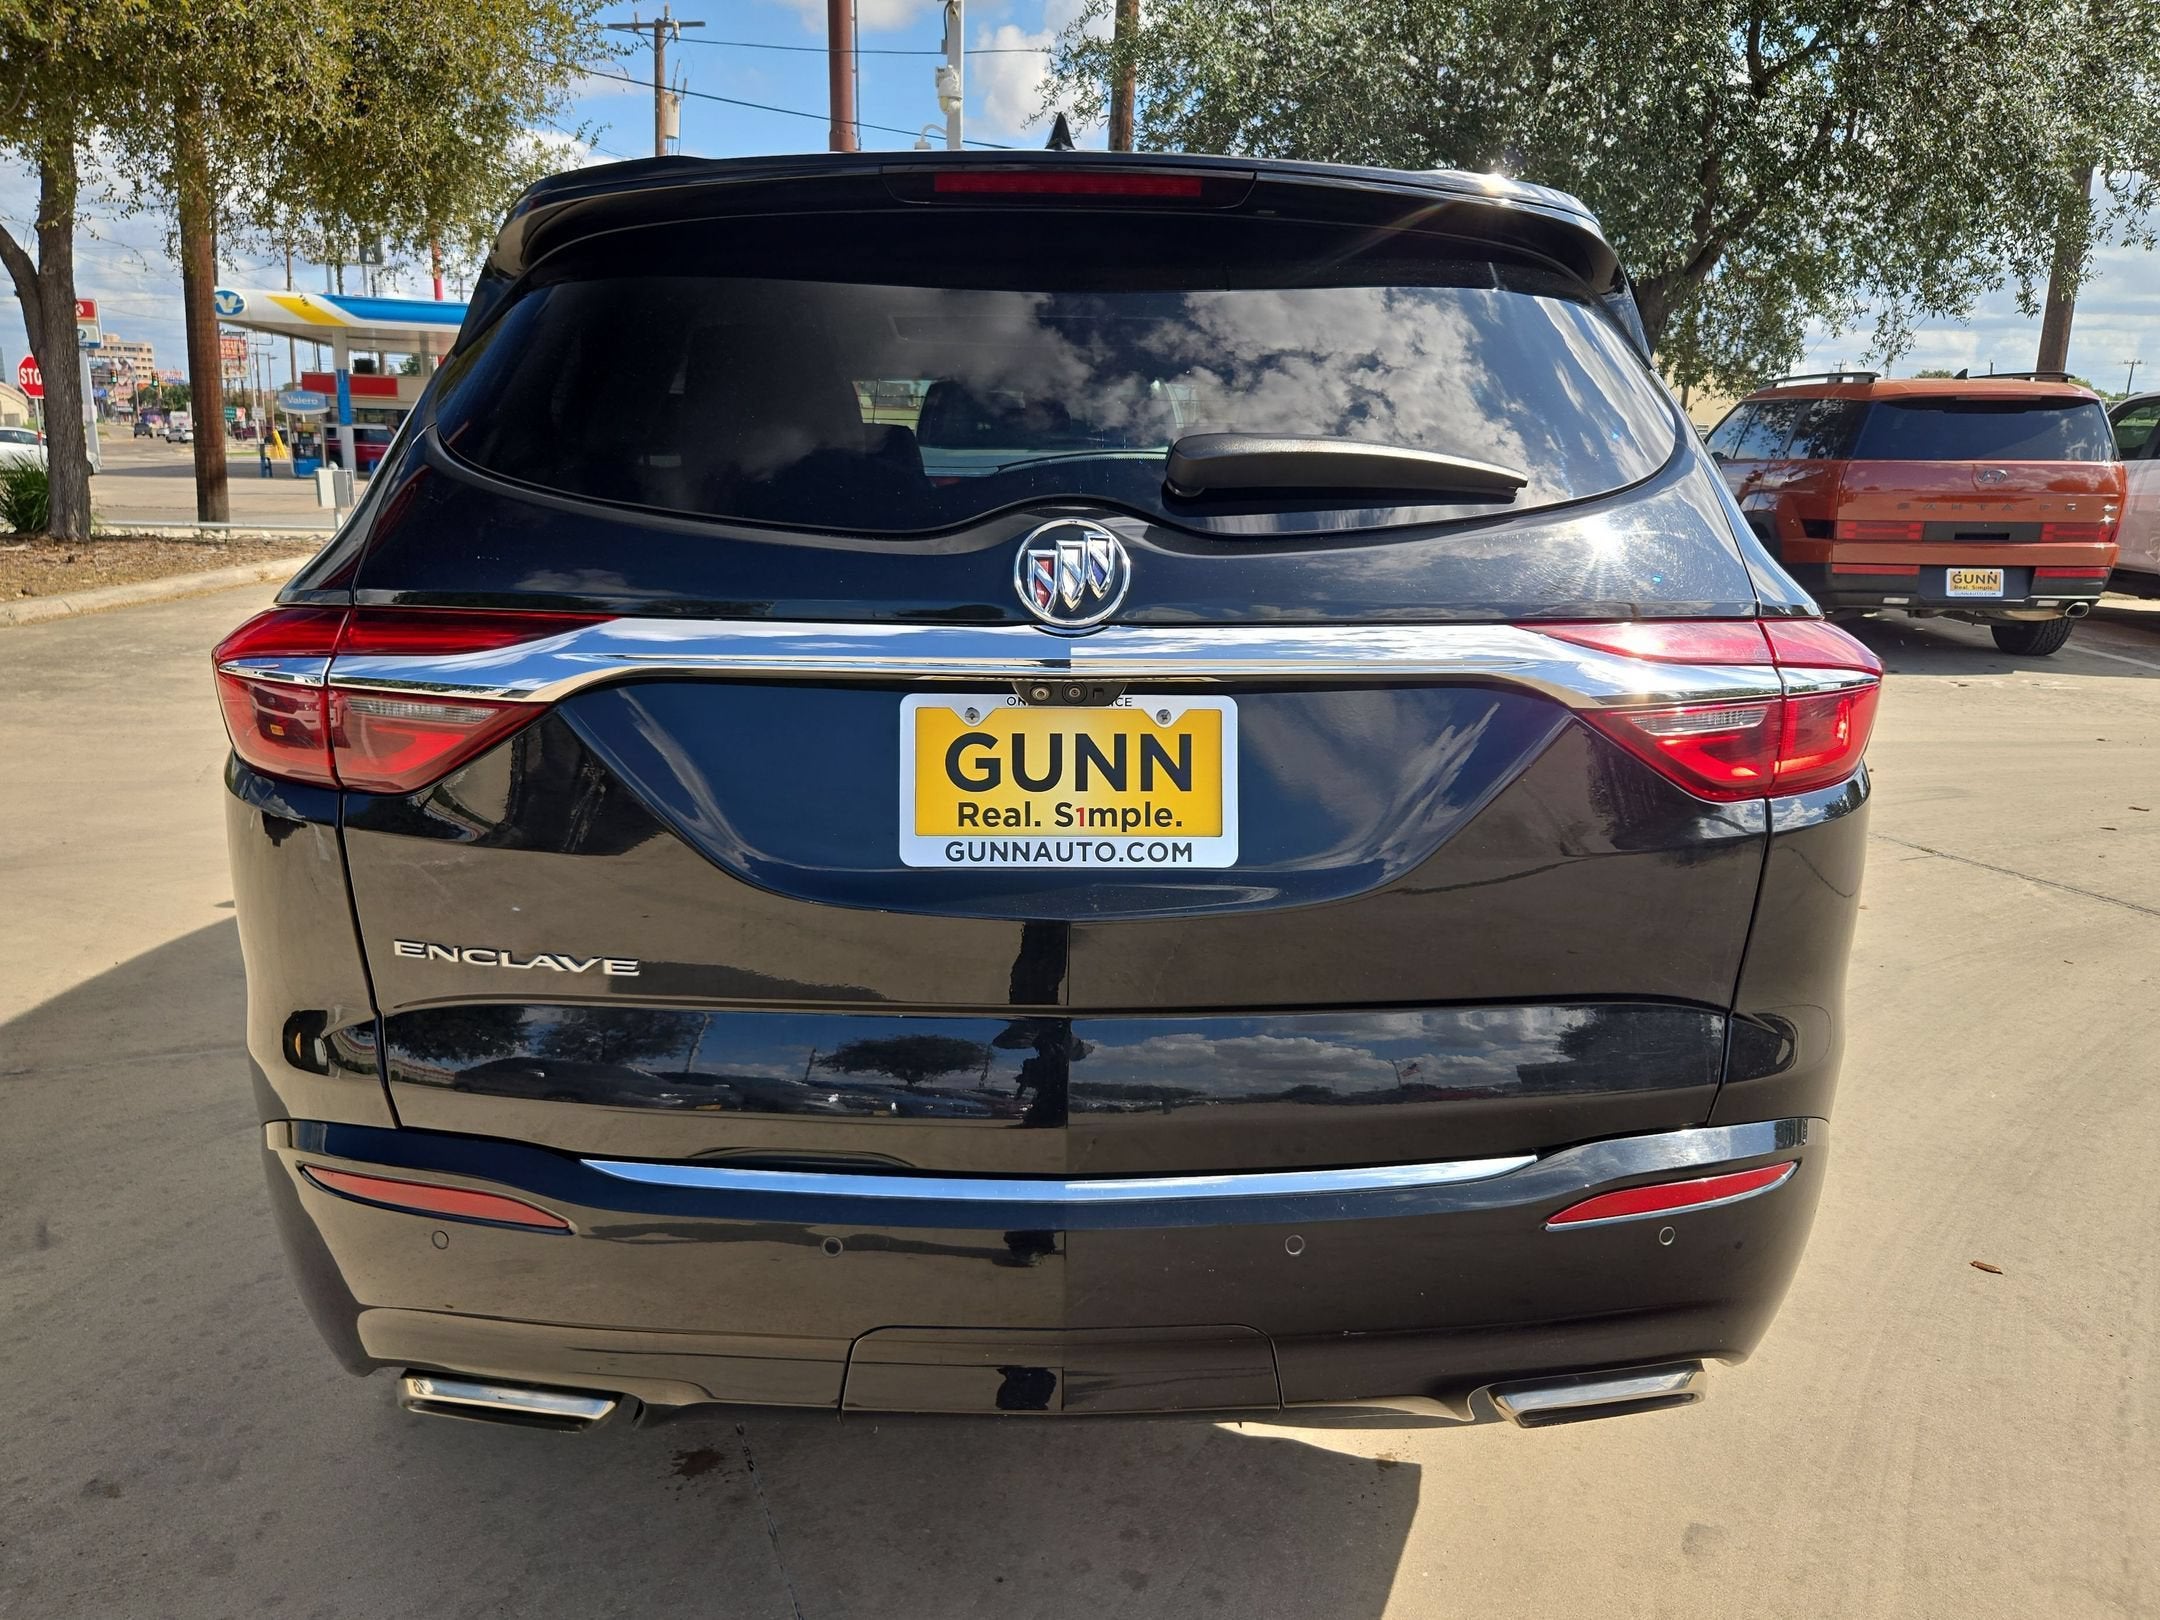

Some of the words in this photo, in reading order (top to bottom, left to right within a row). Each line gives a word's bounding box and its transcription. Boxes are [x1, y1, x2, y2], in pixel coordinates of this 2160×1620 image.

[20, 367, 42, 386] STO
[287, 395, 319, 405] Valero
[1952, 574, 1998, 584] GUNN
[945, 732, 1192, 792] GUNN
[958, 802, 1041, 828] Real.
[945, 842, 1193, 863] GUNNAUTO.COM
[393, 939, 640, 976] ENCLAVE
